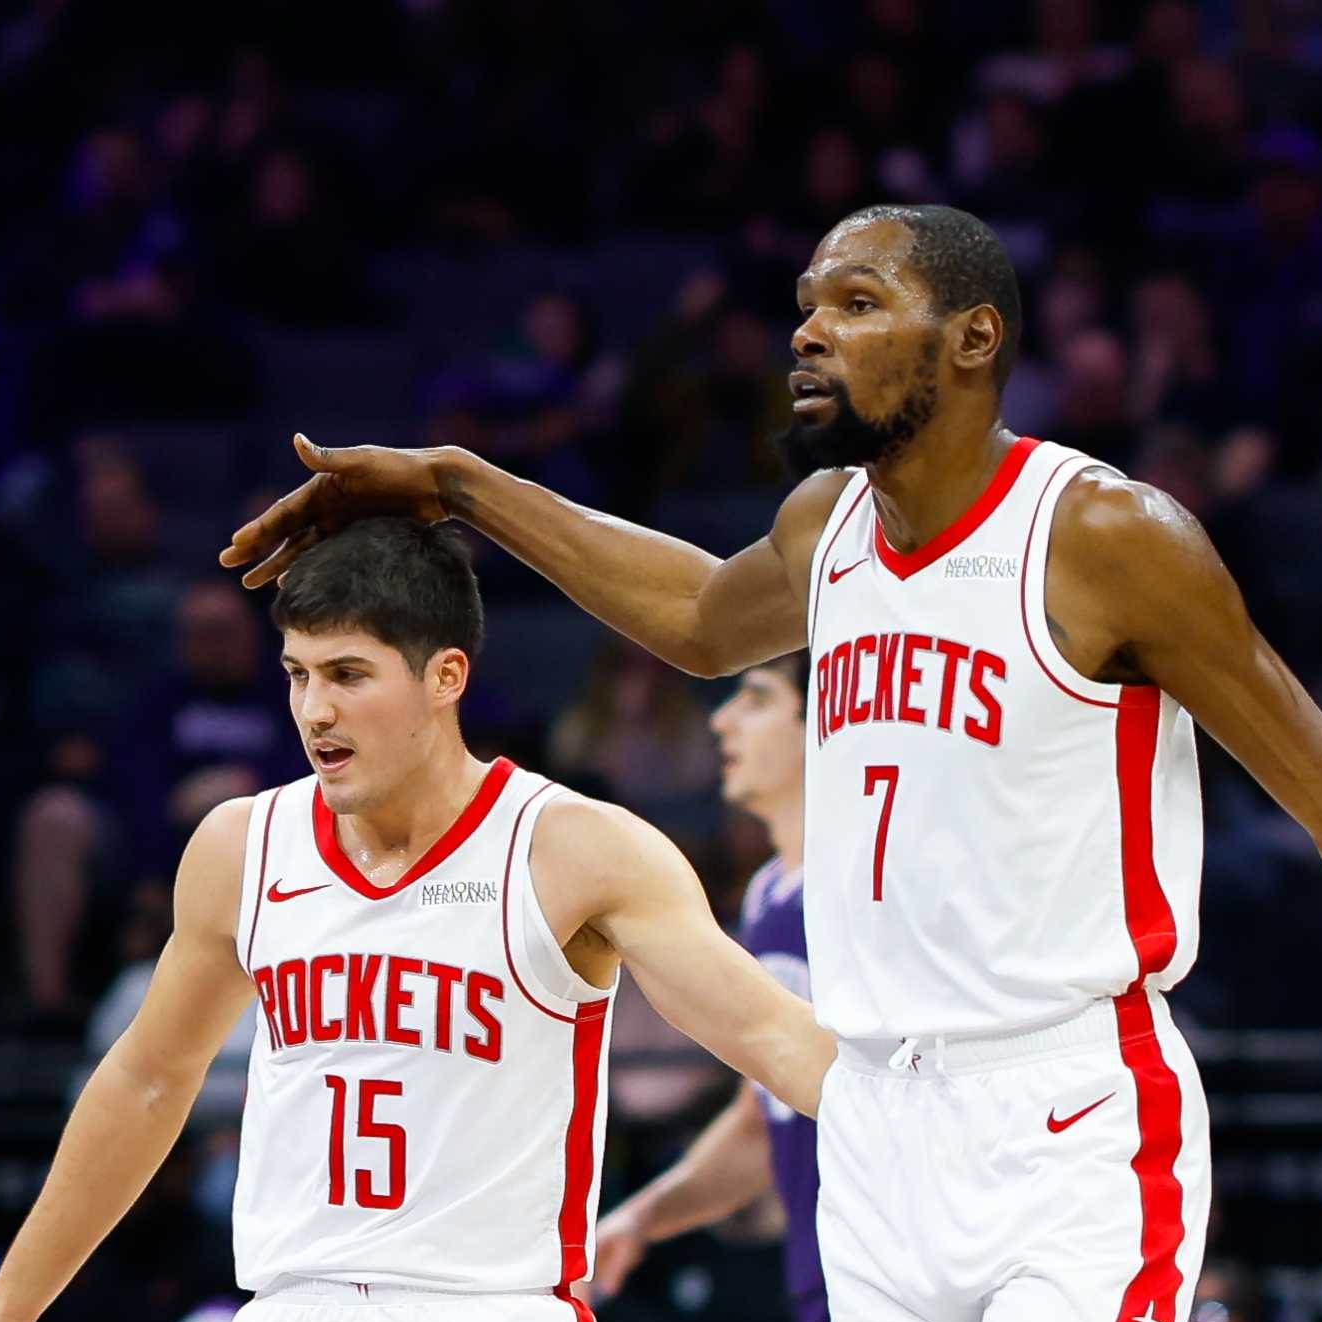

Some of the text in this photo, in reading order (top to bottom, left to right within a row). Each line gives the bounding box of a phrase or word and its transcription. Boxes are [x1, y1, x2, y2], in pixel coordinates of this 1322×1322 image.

[817, 632, 1008, 748] ROCKETS
[422, 882, 498, 896] MEMORIAL
[864, 765, 900, 902] 7
[422, 891, 497, 905] HERMANN
[252, 953, 505, 1063] ROCKETS
[325, 1074, 407, 1211] 15
